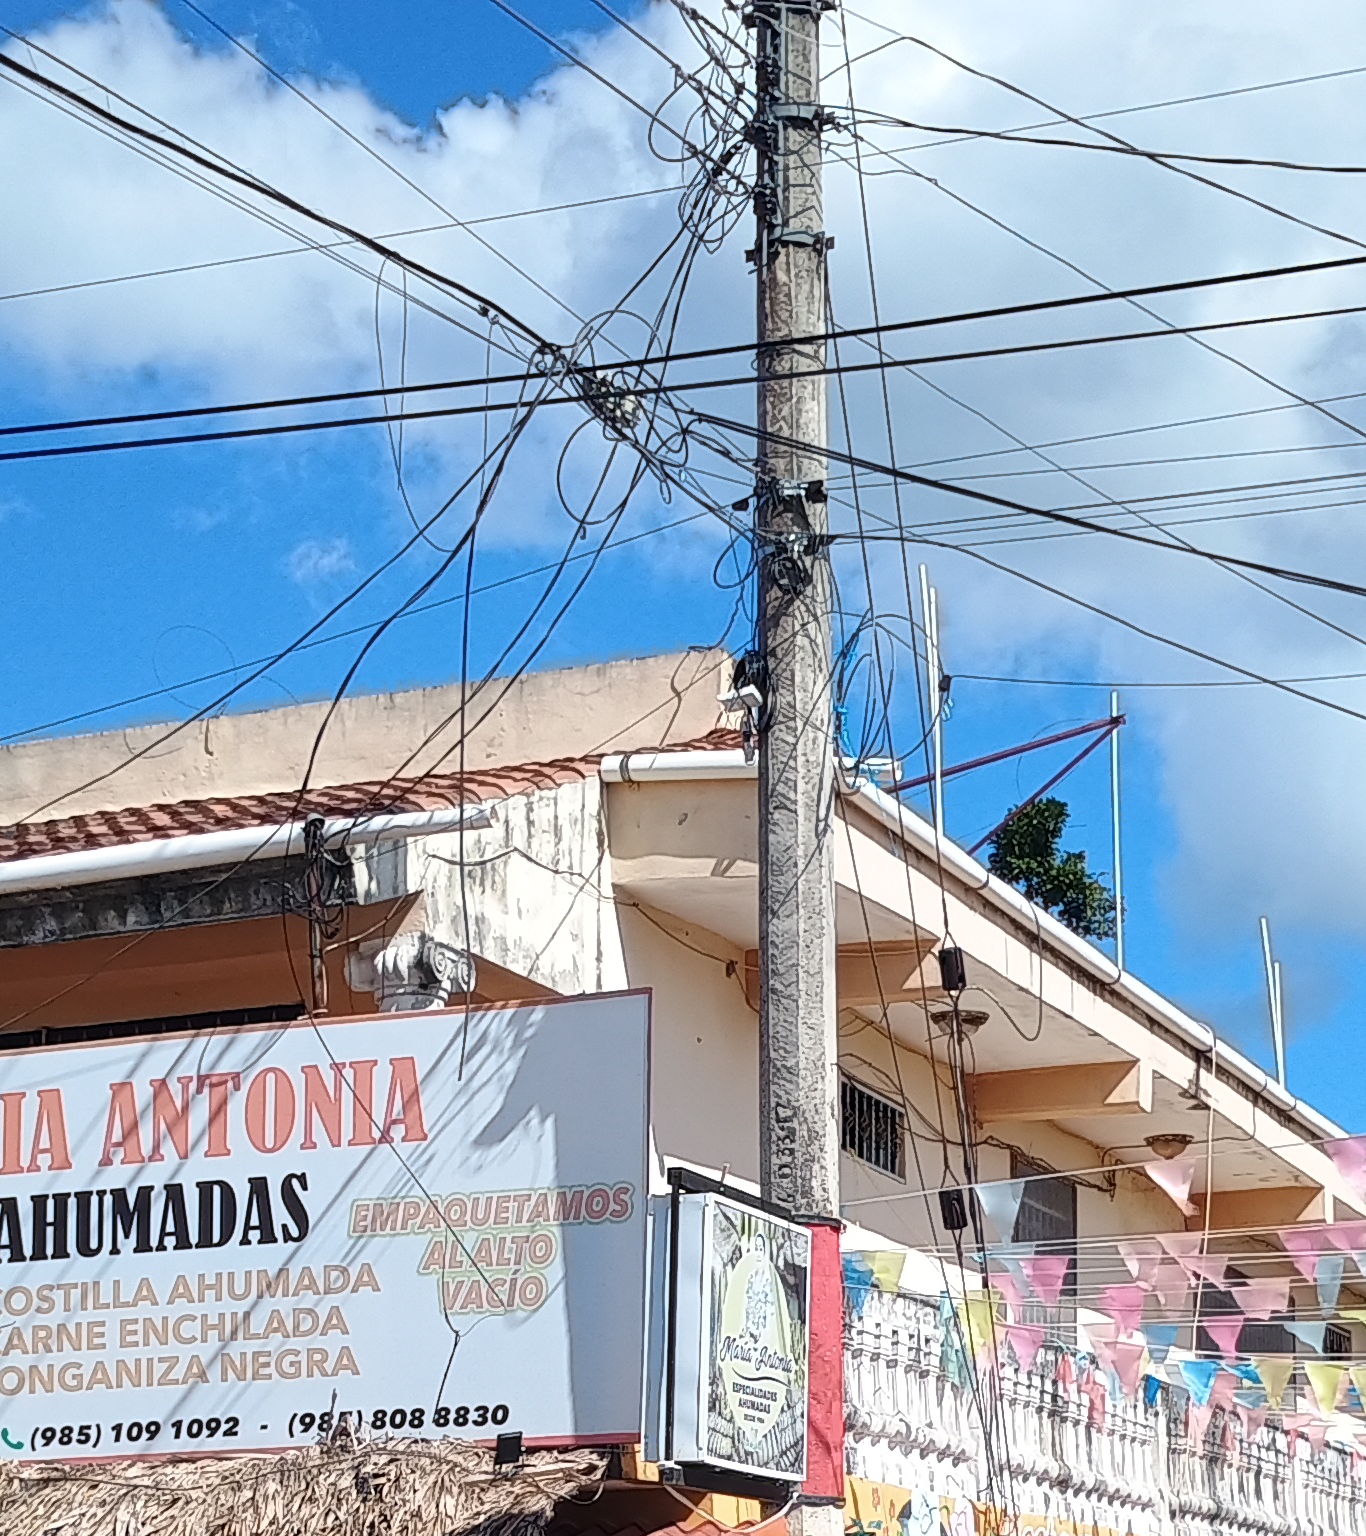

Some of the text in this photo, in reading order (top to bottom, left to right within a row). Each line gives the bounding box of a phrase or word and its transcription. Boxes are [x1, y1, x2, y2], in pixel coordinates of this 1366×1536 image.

[98, 1056, 428, 1169] ANTONIA
[352, 1186, 631, 1233] EMPAQUETAMOS
[422, 1233, 554, 1271] AL ALTO
[166, 1263, 381, 1305] AHUMADA
[443, 1269, 544, 1311] VACÍO
[119, 1305, 351, 1349] ENCHILADA
[220, 1345, 360, 1384] NEGRA
[30, 1421, 102, 1451] (985)
[110, 1418, 161, 1445] 109
[169, 1416, 240, 1442] 1092
[371, 1408, 426, 1430] 808
[434, 1404, 510, 1428] 8830
